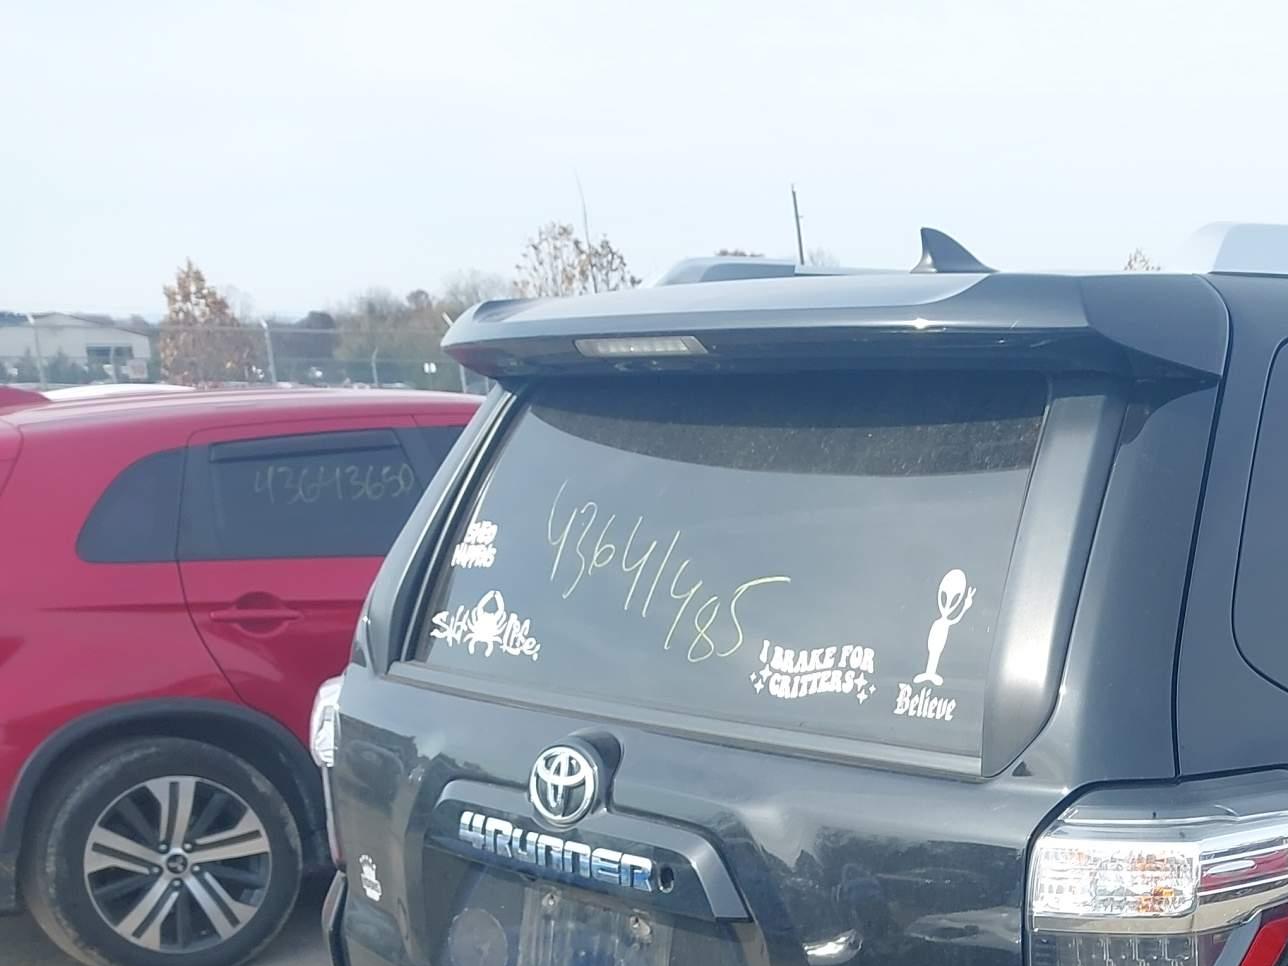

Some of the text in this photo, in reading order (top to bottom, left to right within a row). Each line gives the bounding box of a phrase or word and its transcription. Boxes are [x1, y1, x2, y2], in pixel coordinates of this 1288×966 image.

[547, 480, 792, 663] 43641485
[759, 639, 875, 673] I BRAKE FOR
[769, 669, 855, 699] CRITTERS
[894, 683, 957, 721] Believe
[459, 810, 652, 891] 4RUNNER
